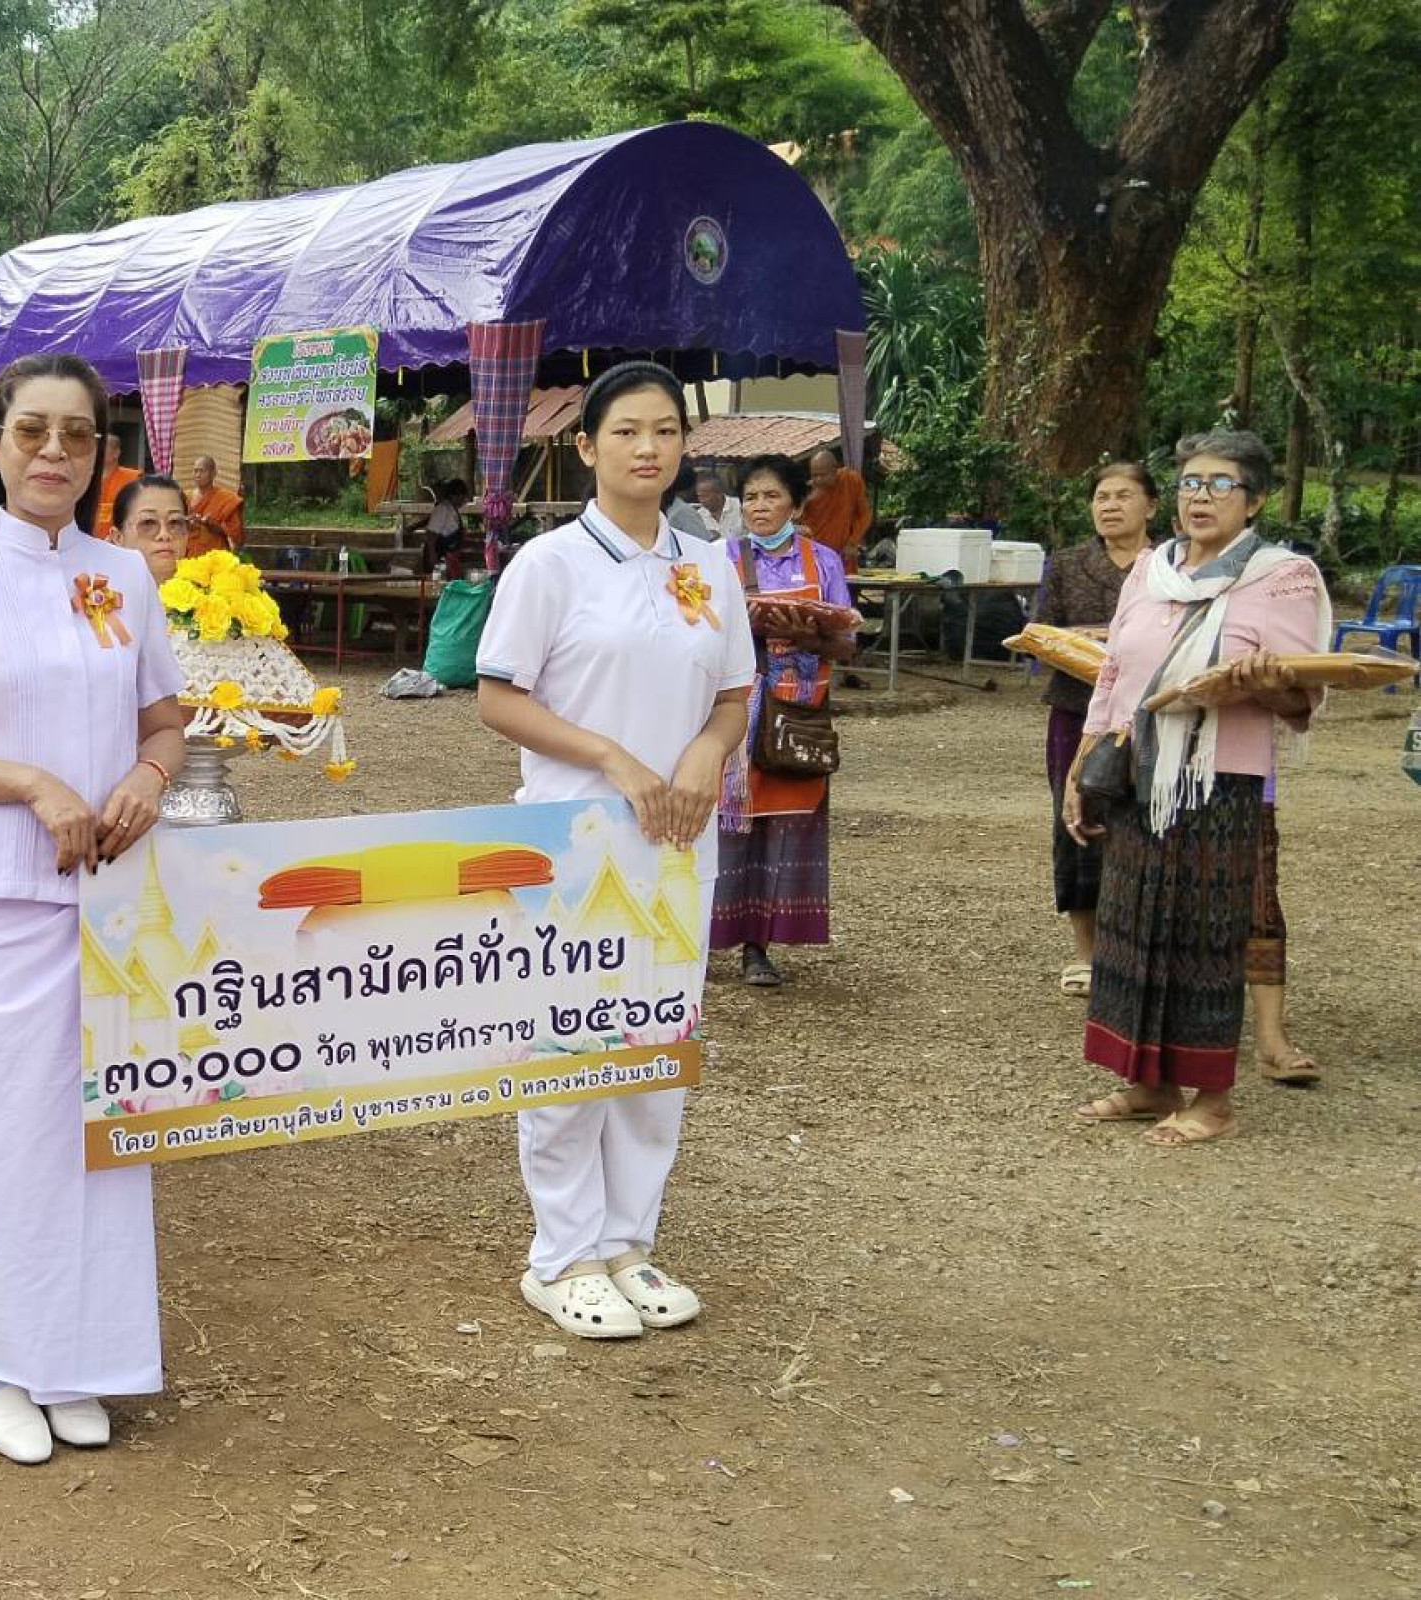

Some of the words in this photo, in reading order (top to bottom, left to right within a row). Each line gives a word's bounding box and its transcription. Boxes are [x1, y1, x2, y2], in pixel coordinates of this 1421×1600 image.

[175, 917, 626, 1031] กฐินสามัคคีทั่วไทย
[105, 1043, 302, 1094] ๓๐,๐๐๐
[317, 1033, 357, 1066] วัด
[368, 1018, 536, 1070] พุทธศักราช
[548, 992, 686, 1036] ๒๕๖๘
[112, 1131, 156, 1154] โดย
[166, 1100, 344, 1144] คณะศิษยานุศิษย์
[353, 1091, 452, 1125] บูชาธรรม
[499, 1078, 513, 1099] ปี
[522, 1057, 679, 1096] หลวงพ่อธัมมชโย
